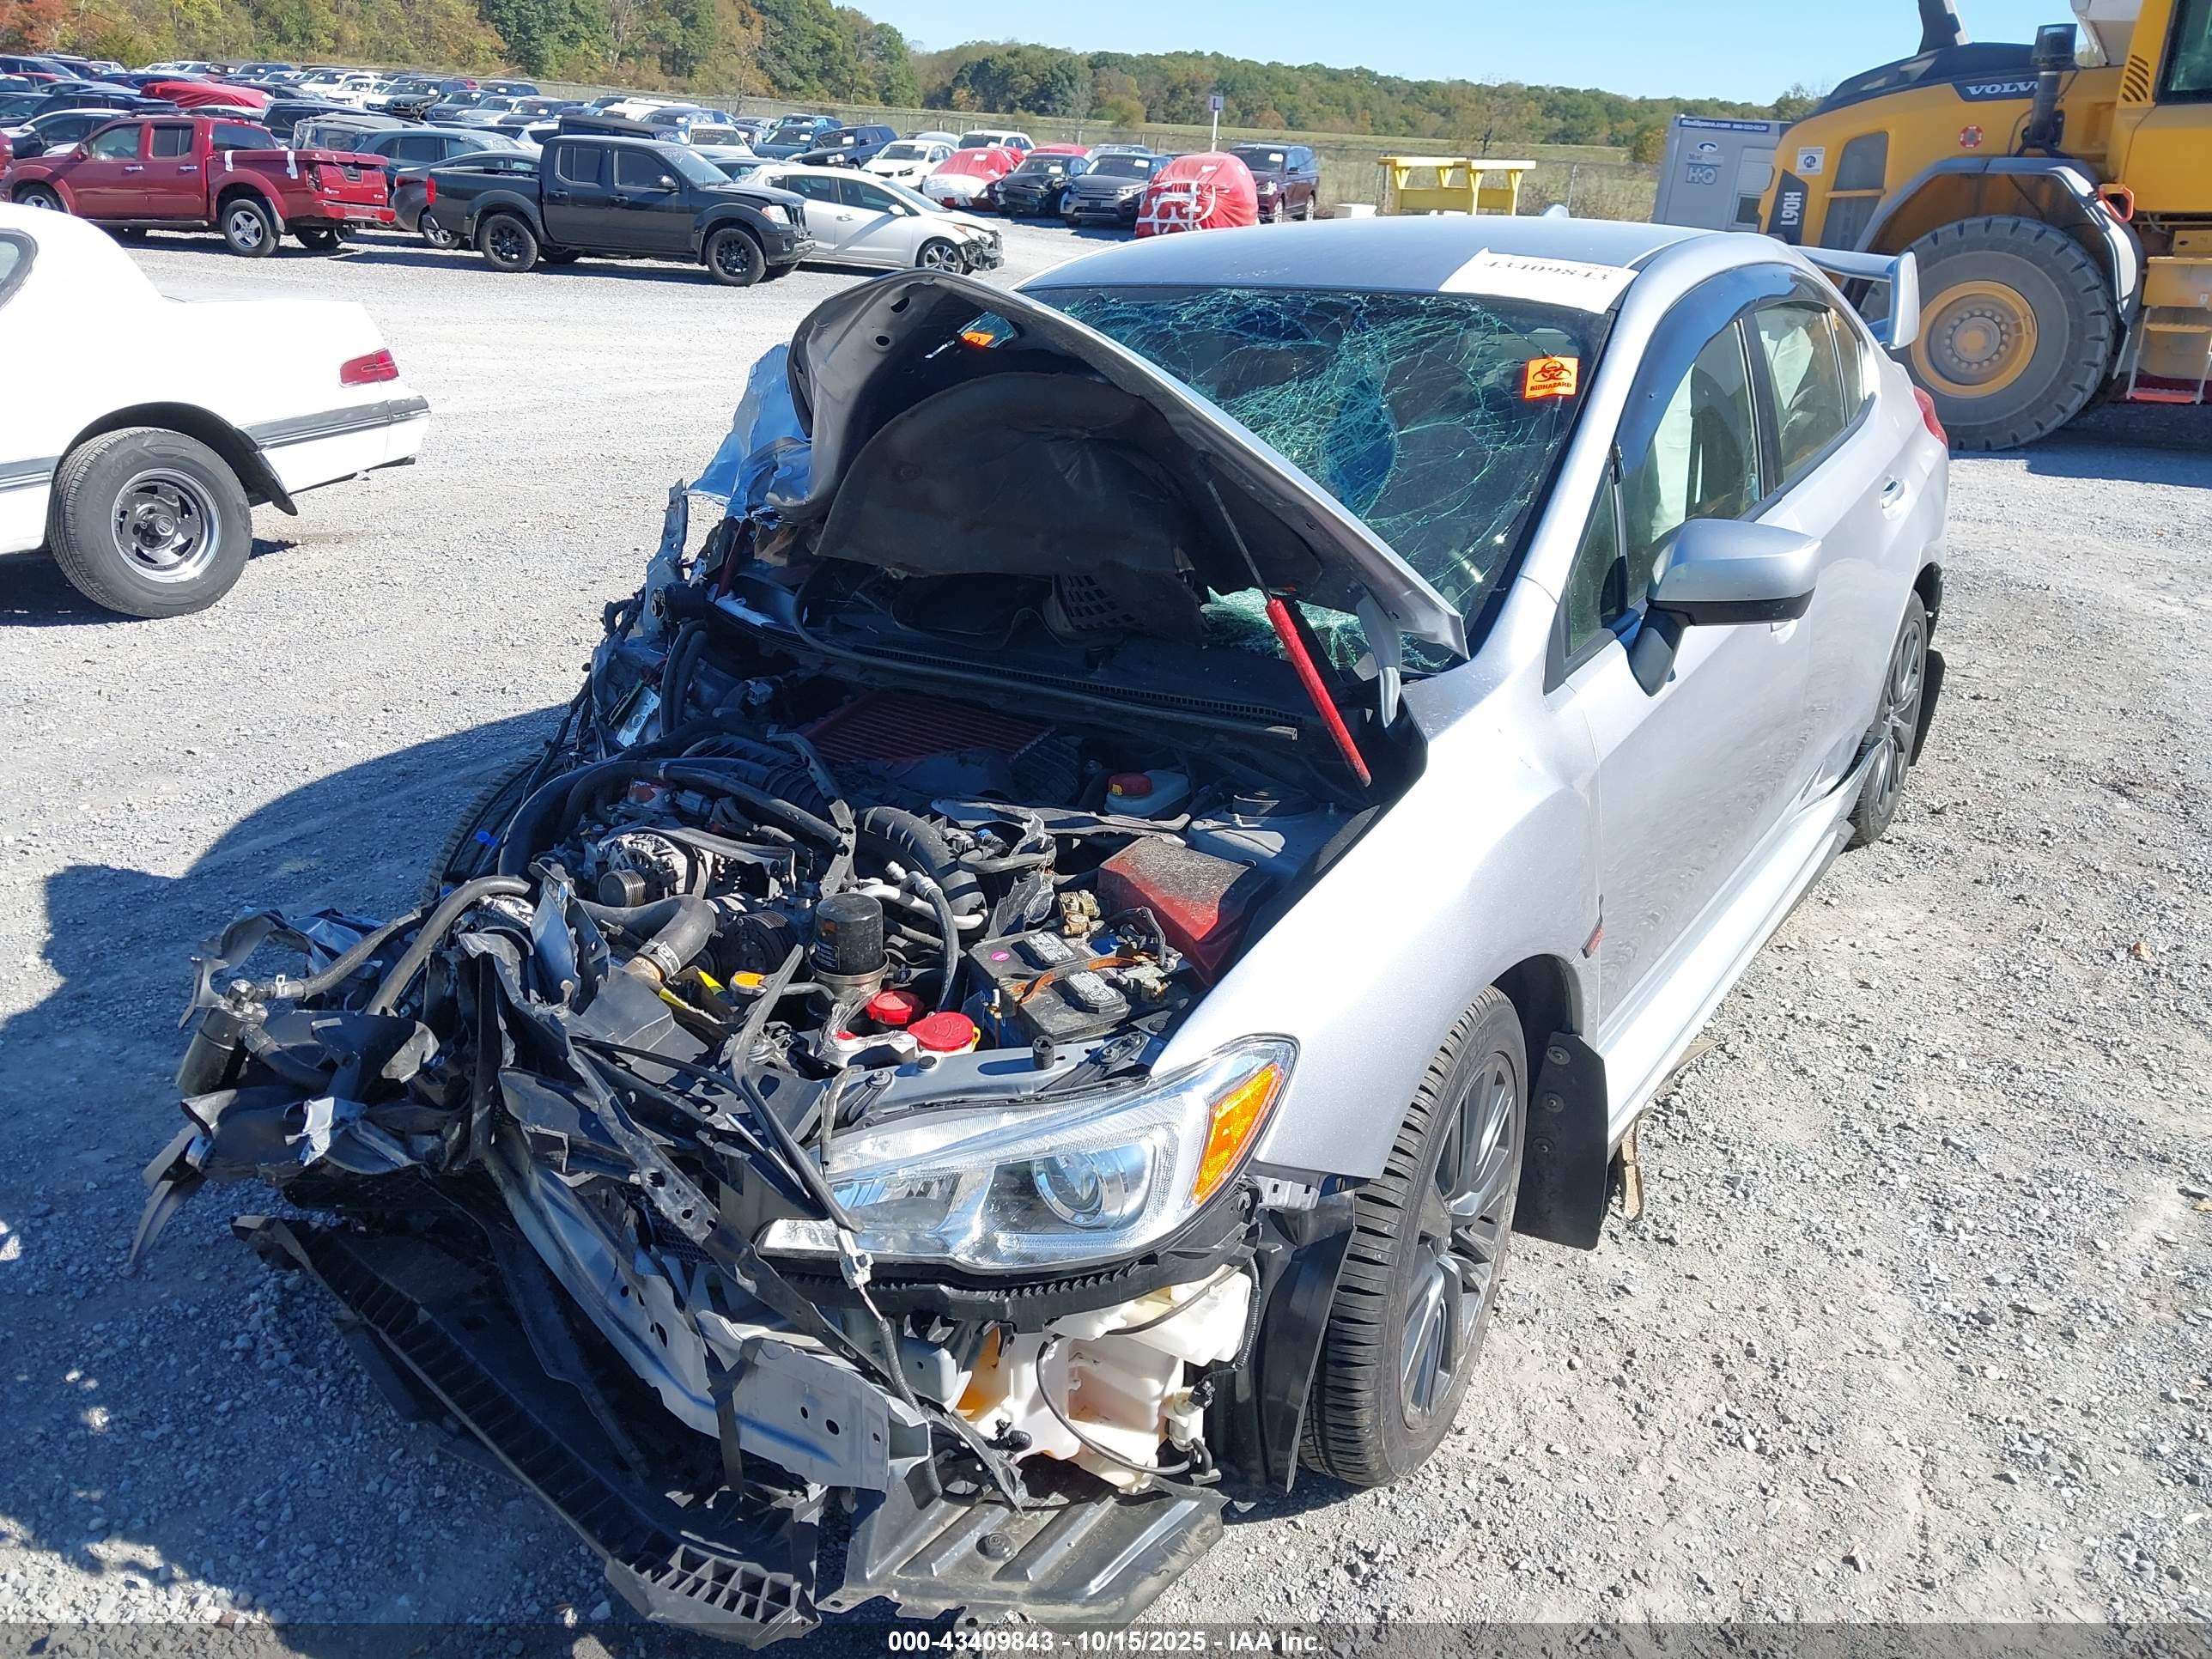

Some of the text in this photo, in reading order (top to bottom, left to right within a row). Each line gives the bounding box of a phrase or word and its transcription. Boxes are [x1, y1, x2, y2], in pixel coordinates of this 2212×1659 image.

[1212, 97, 1220, 110] L
[1780, 191, 1802, 226] L90H
[1484, 261, 1608, 281] 43409843
[1529, 381, 1572, 392] BIOHAZARD
